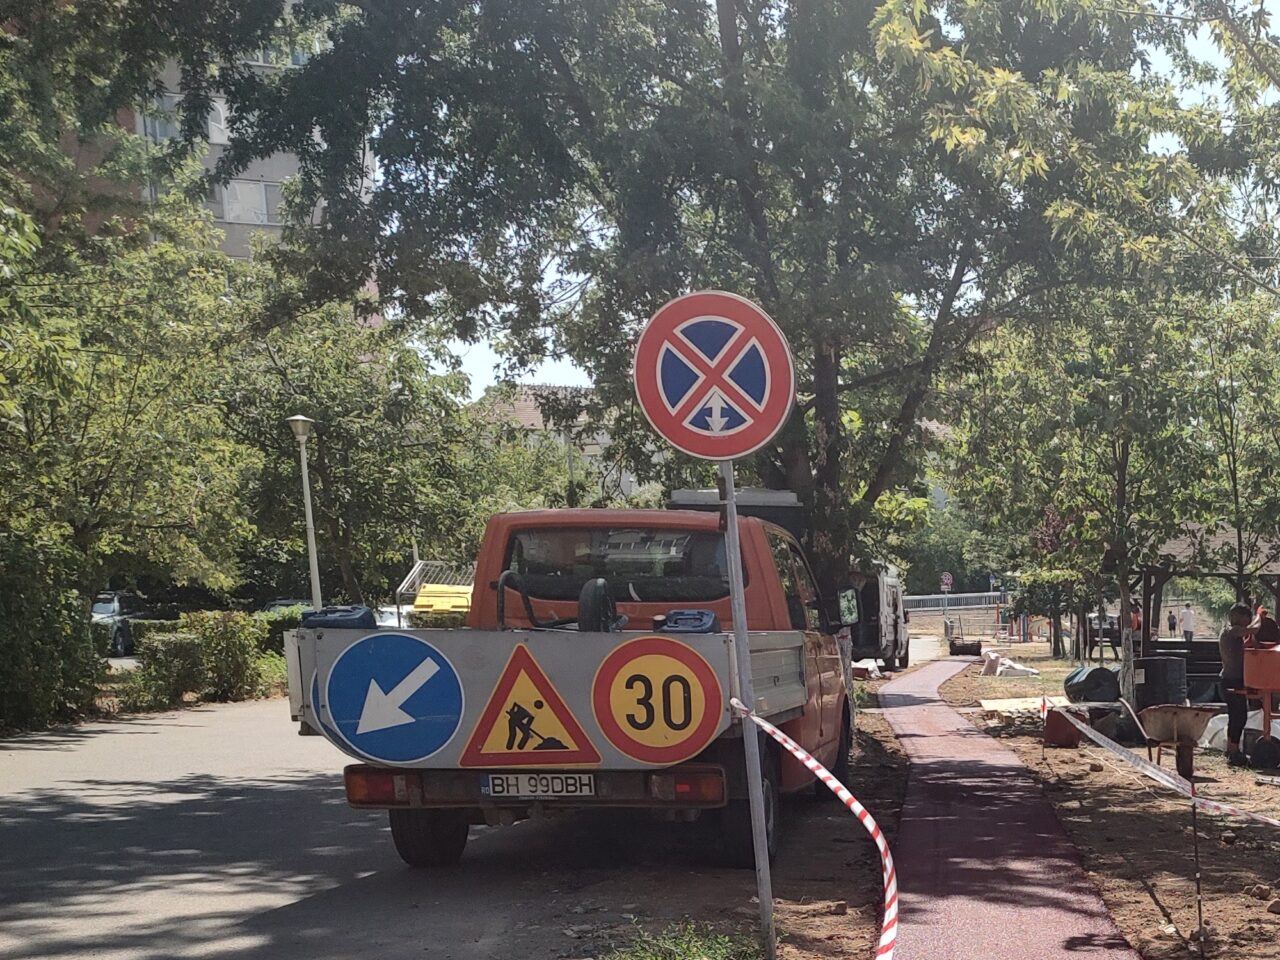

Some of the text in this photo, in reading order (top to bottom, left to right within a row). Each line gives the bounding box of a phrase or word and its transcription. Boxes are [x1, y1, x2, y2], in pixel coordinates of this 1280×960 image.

[625, 673, 692, 731] 30
[491, 776, 593, 794] BH 99DBH
